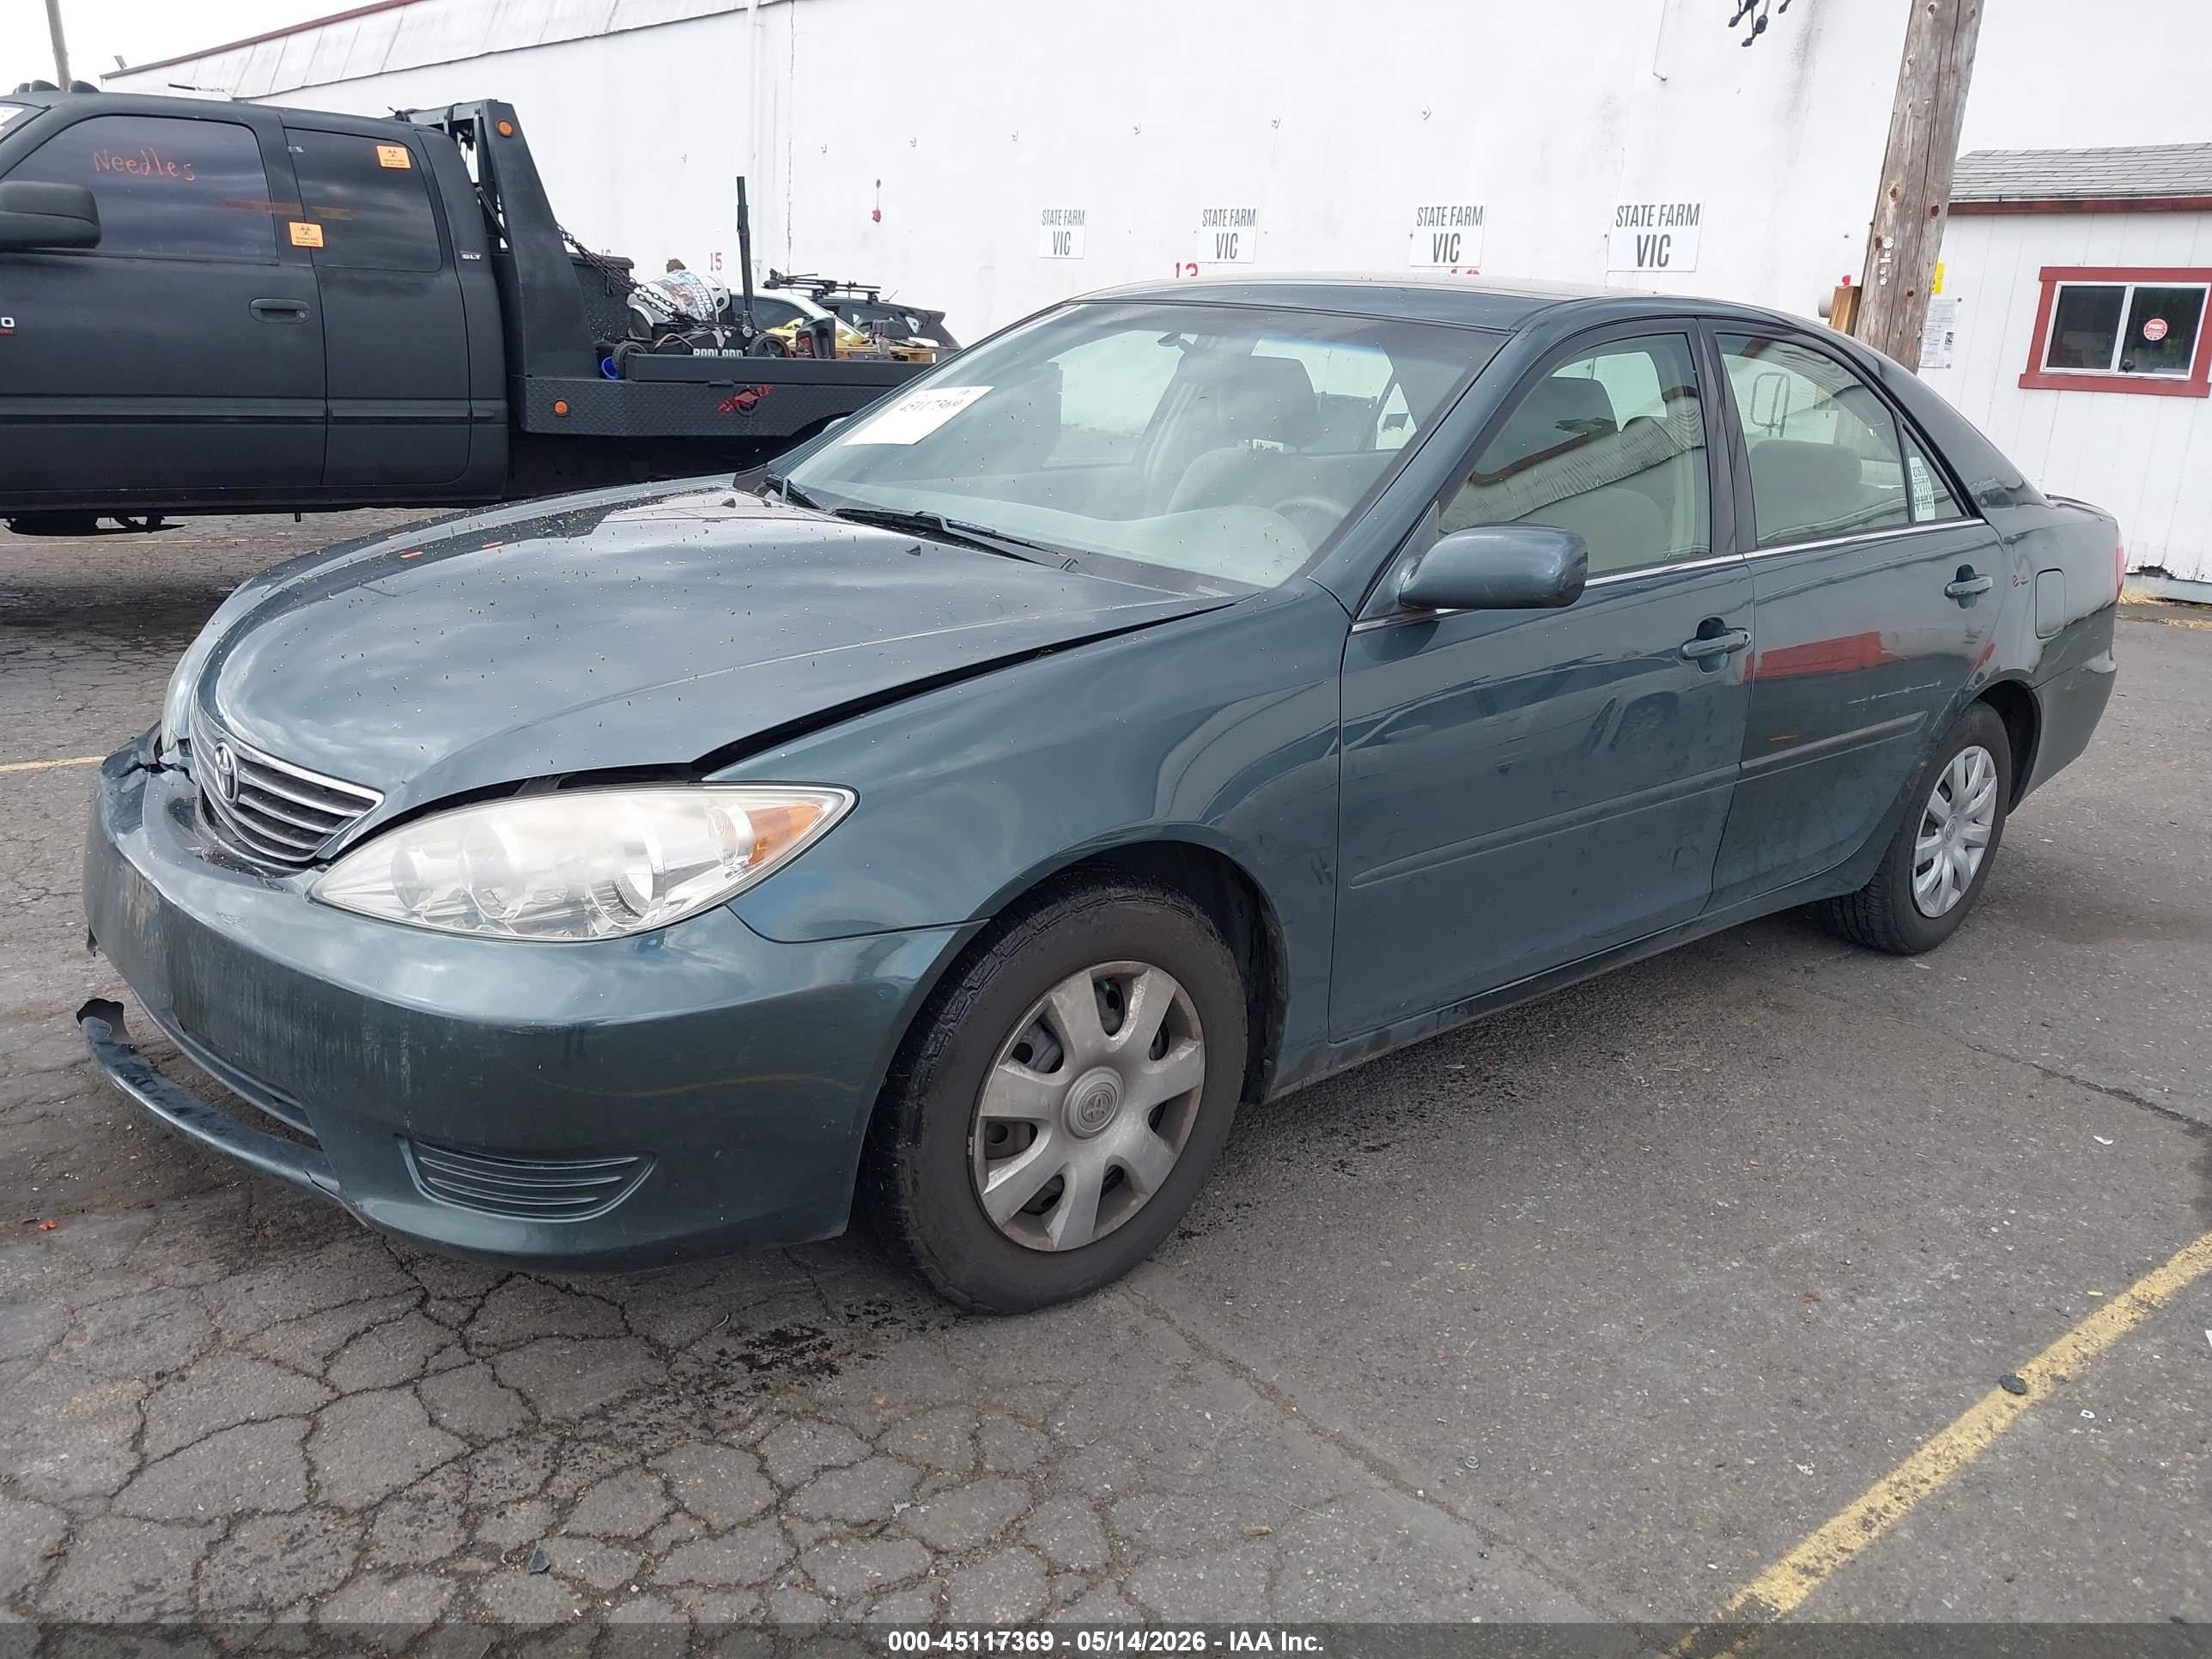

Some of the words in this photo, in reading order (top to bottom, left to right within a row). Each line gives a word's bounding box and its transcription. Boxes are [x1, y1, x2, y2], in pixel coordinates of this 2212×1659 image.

[93, 147, 195, 181] Needles
[1042, 209, 1062, 226] STATE
[1063, 209, 1085, 226] FARM
[1202, 209, 1228, 227] STATE
[1230, 208, 1256, 227] FARM
[1416, 206, 1448, 227] STATE
[1449, 205, 1484, 227] FARM
[1615, 204, 1656, 228] STATE
[1658, 203, 1700, 227] FARM
[1053, 230, 1072, 256] VIC
[1216, 232, 1238, 259] VIC
[1433, 233, 1461, 263] VIC
[1637, 234, 1672, 268] VIC
[709, 252, 723, 272] 15
